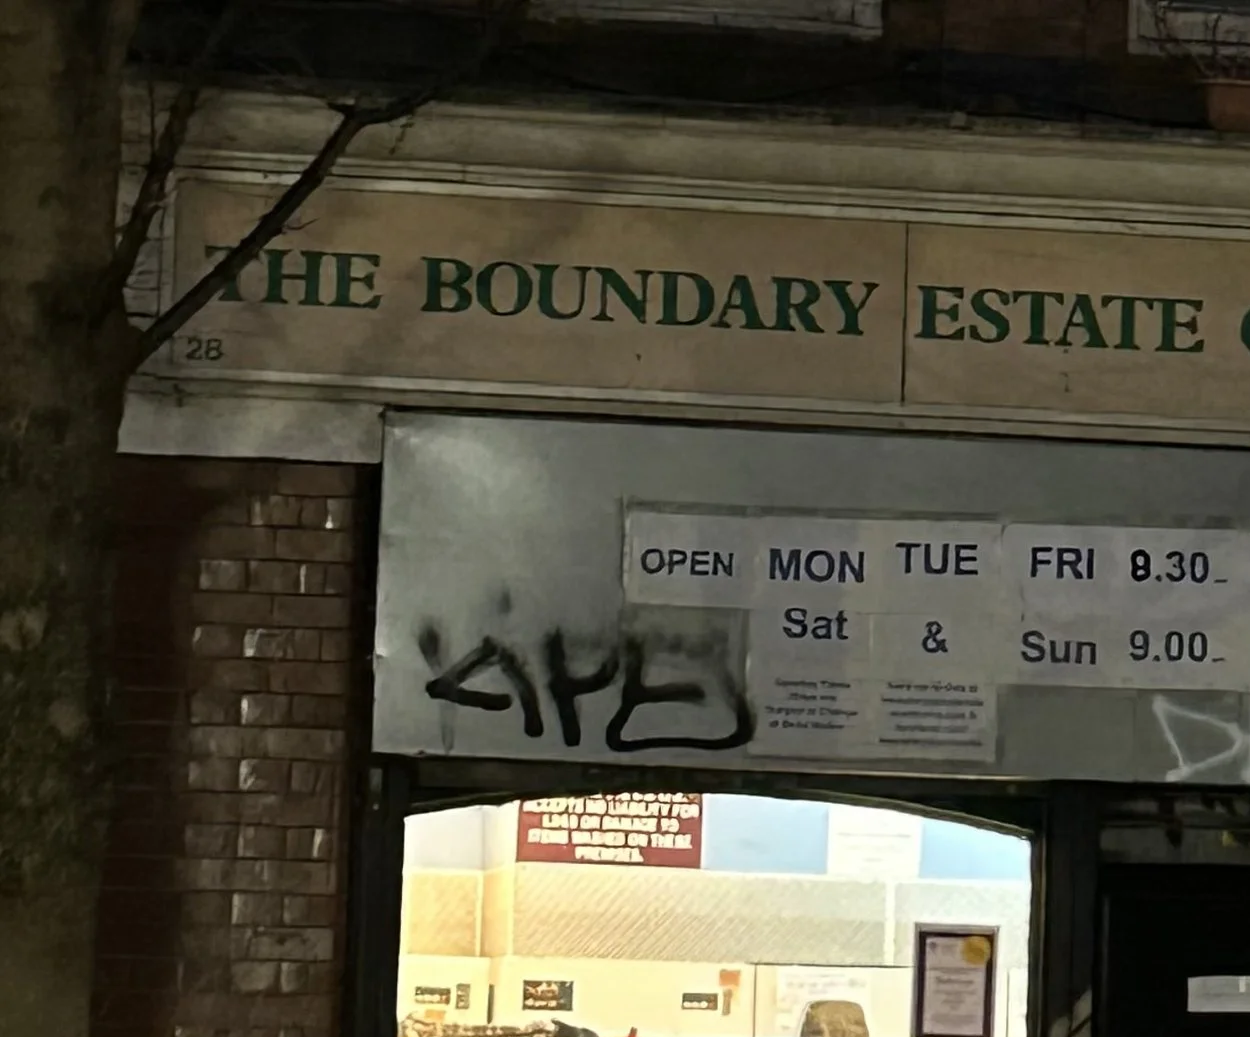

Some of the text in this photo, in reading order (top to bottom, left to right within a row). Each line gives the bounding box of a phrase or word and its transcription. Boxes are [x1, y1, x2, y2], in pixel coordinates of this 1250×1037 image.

[421, 255, 880, 336] BOUNDARY
[915, 284, 1206, 354] ESTATE
[185, 337, 223, 361] 28
[640, 548, 735, 577] OPEN
[768, 547, 866, 583] MON
[896, 541, 979, 576] TUE
[1030, 547, 1095, 580] FRI
[782, 607, 849, 640] Sat
[921, 620, 949, 654] &
[1020, 630, 1097, 665] Sun
